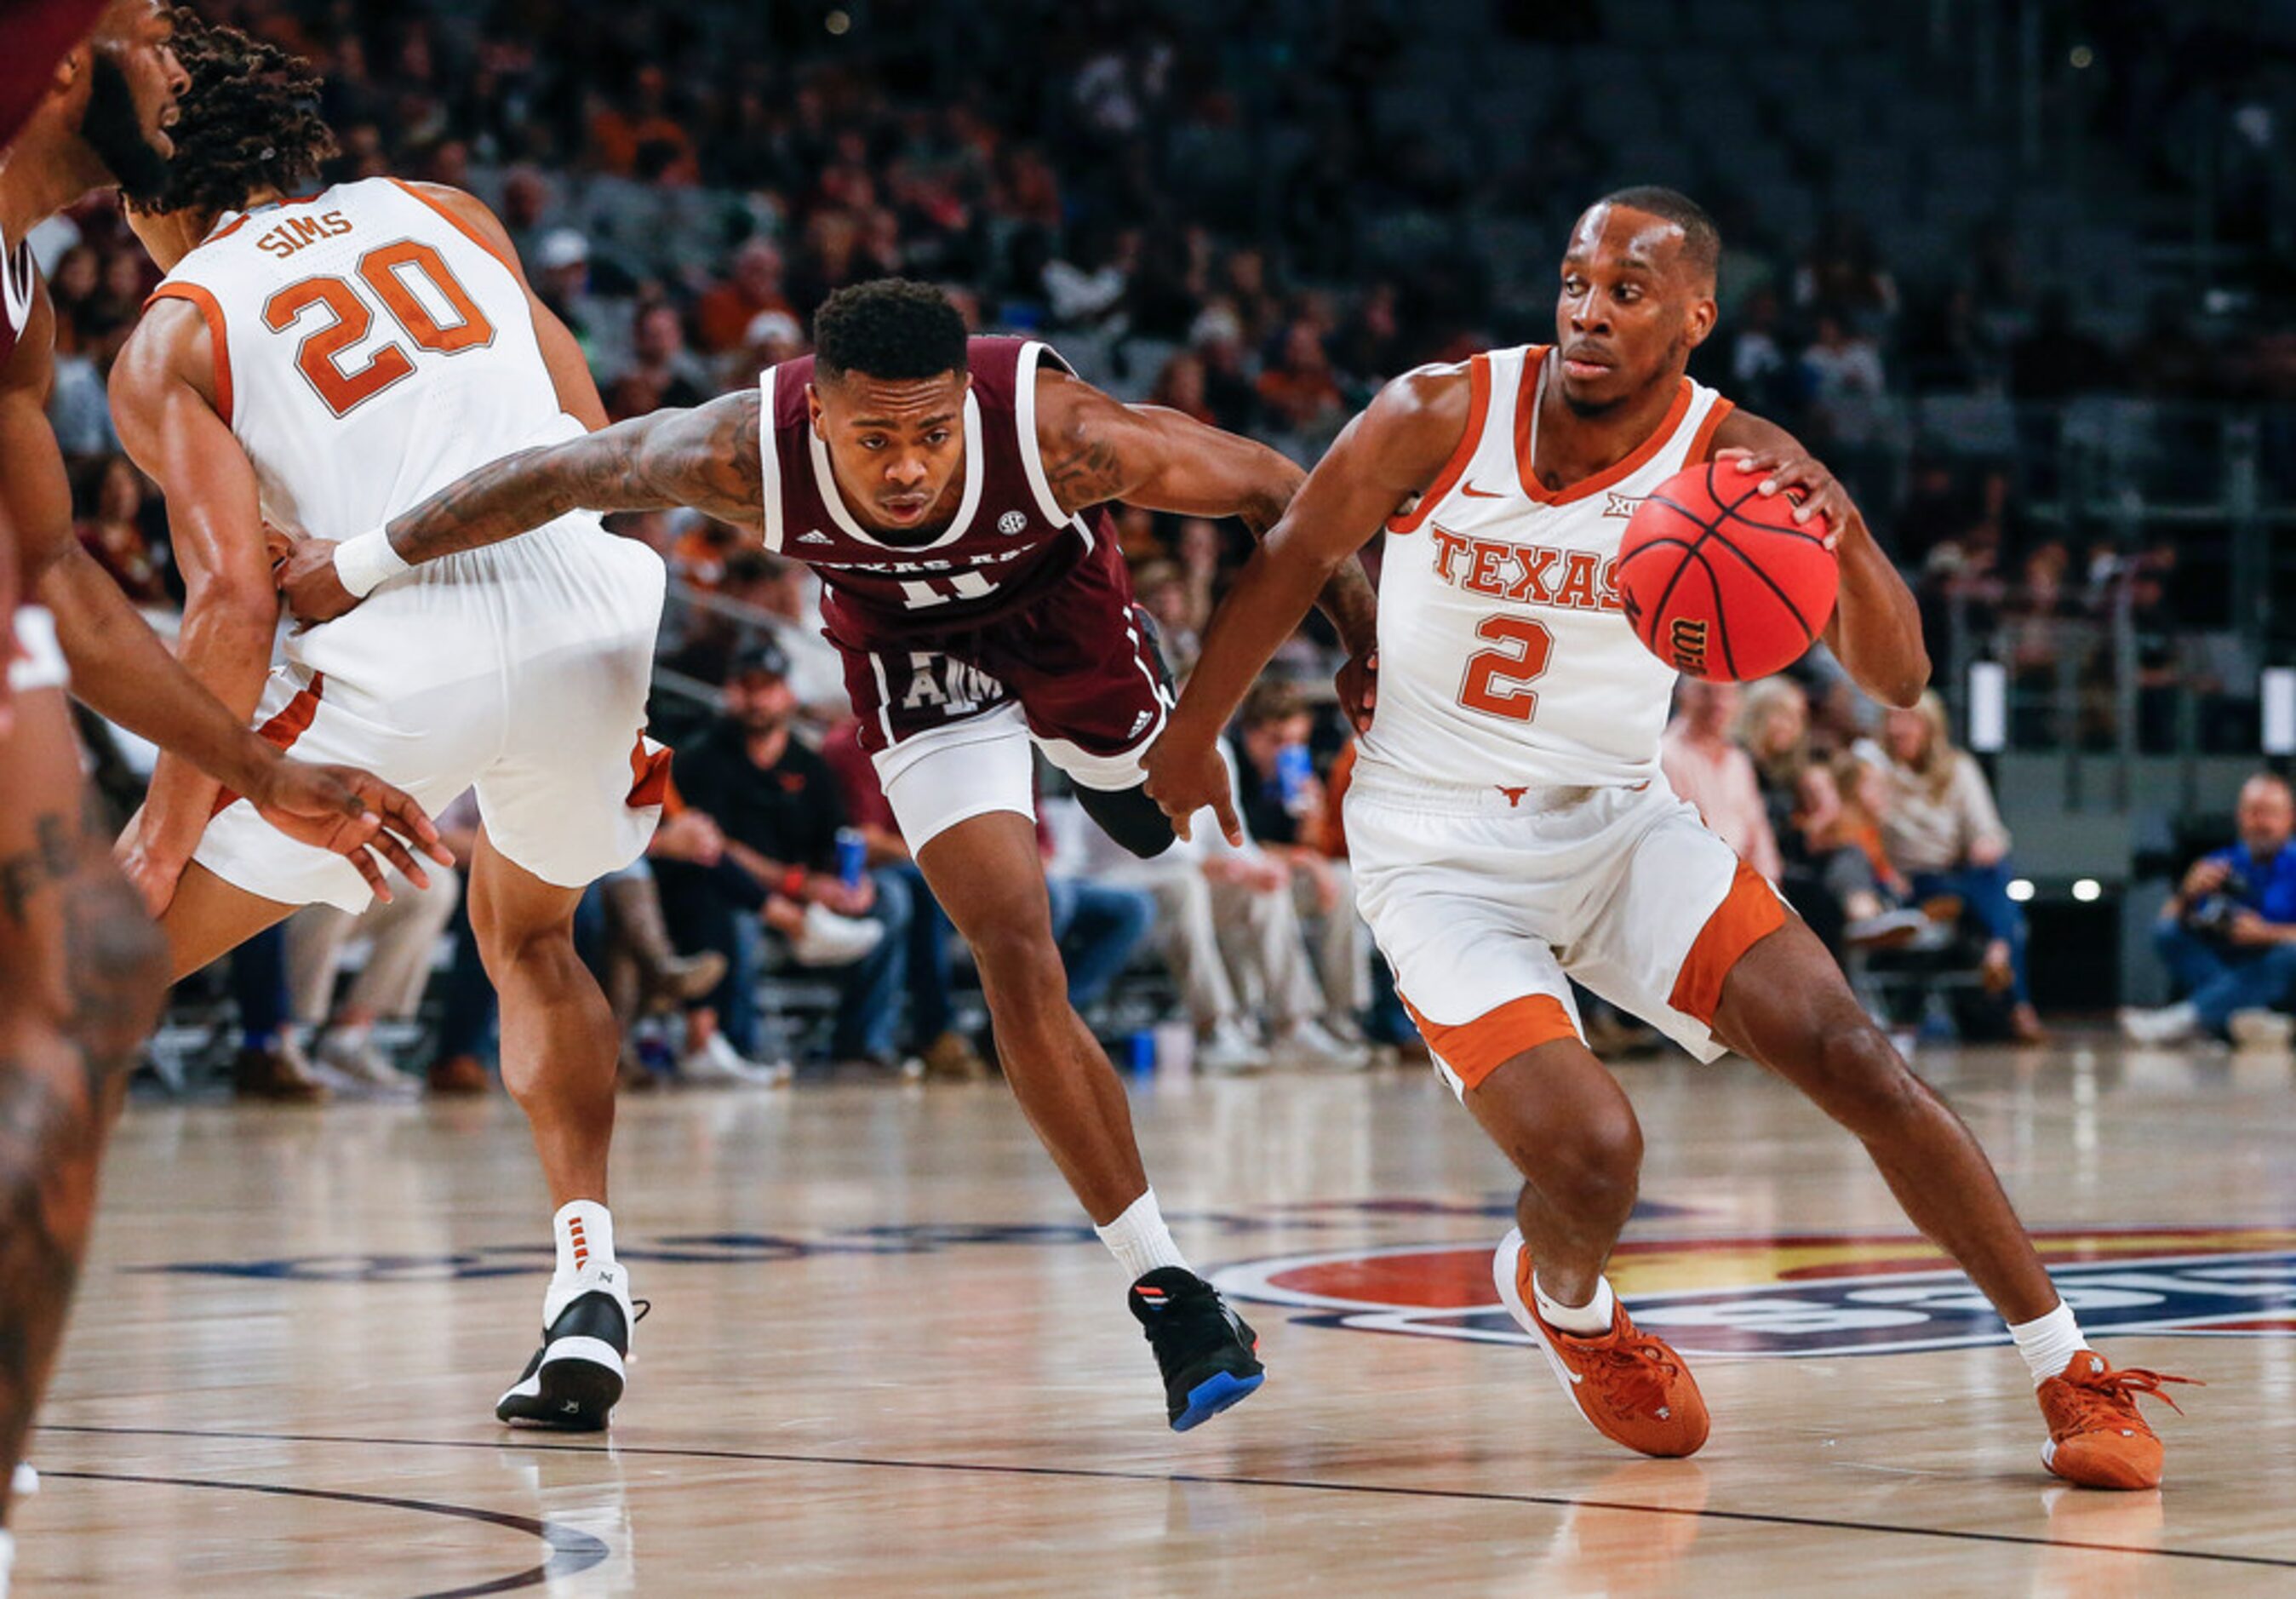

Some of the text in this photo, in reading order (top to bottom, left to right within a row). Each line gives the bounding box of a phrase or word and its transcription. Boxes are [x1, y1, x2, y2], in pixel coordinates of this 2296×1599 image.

[256, 209, 353, 259] SIMS
[260, 236, 499, 421] 20
[1456, 612, 1556, 725] 2
